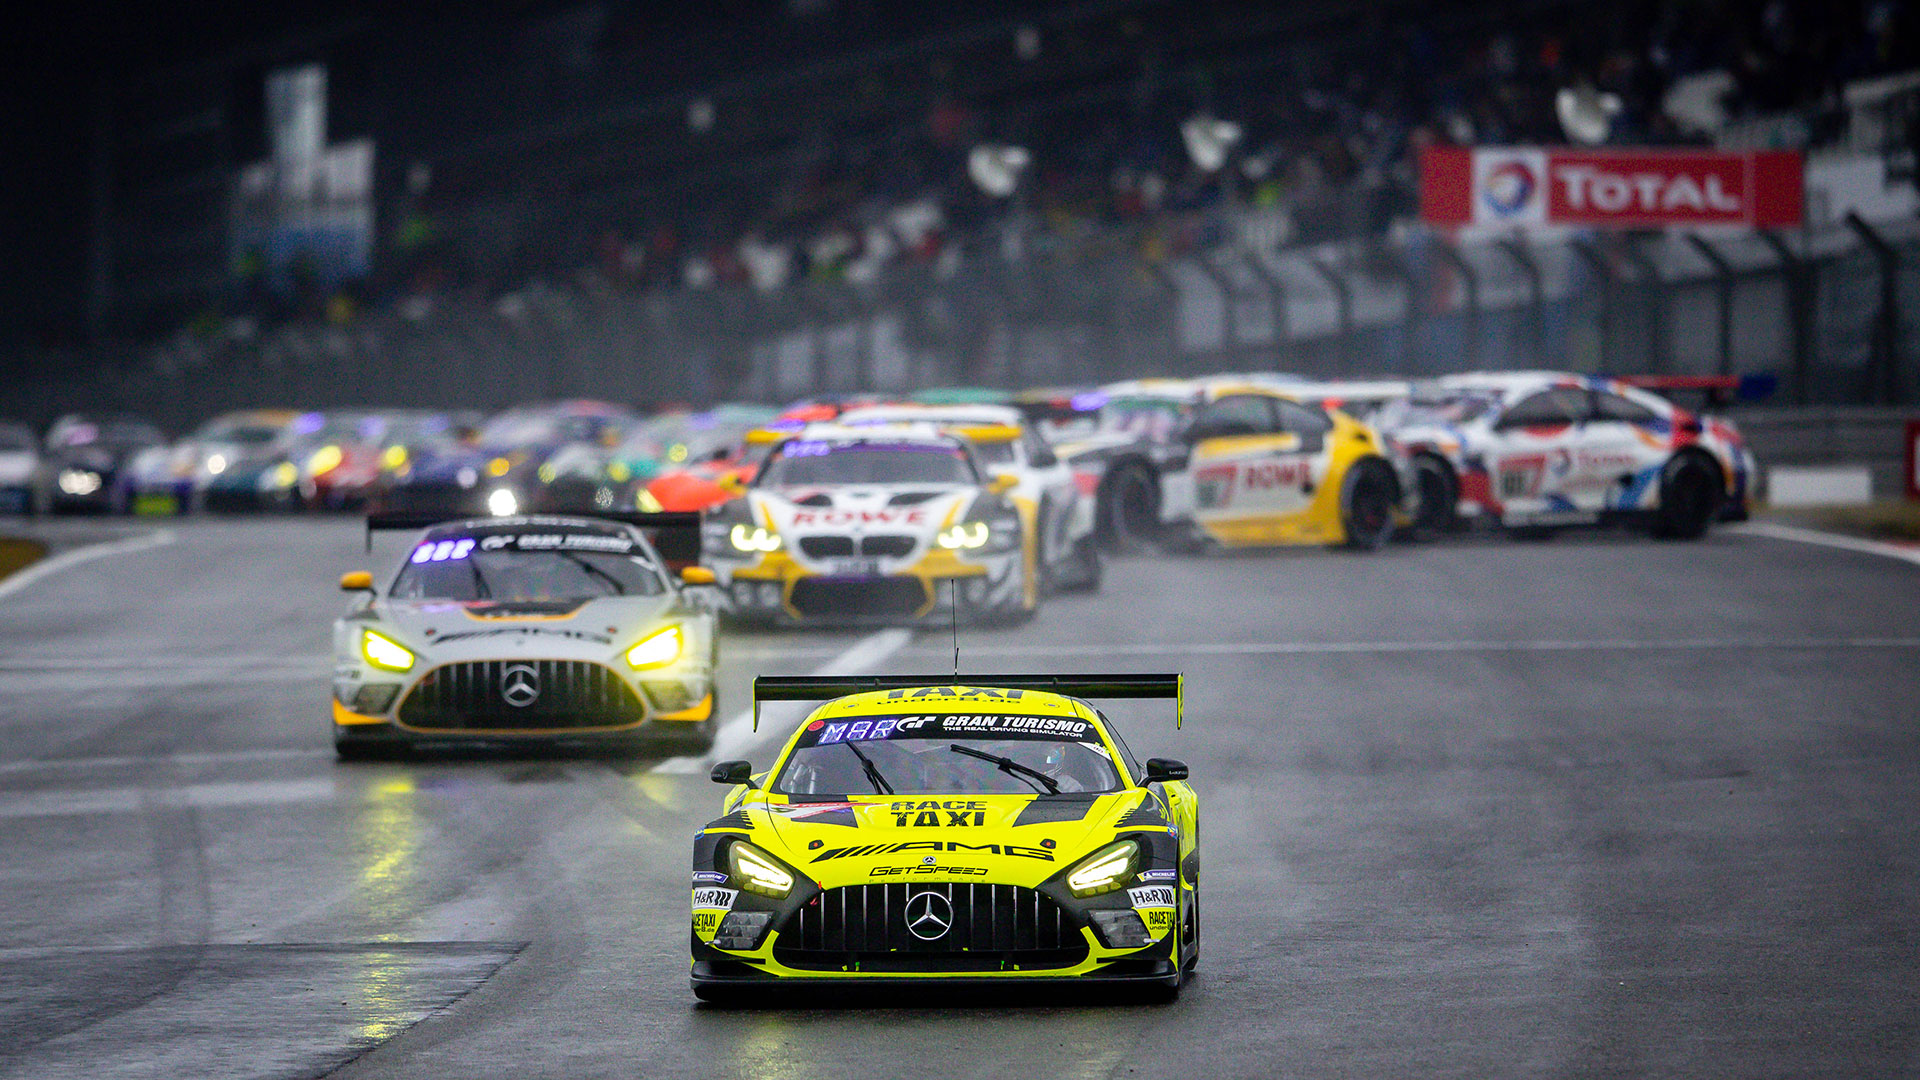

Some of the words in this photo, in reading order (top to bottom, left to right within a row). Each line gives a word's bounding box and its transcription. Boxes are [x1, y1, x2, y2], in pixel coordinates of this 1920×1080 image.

[1557, 164, 1740, 212] TOTAL
[792, 510, 927, 527] ROWE
[942, 716, 999, 727] GRAN
[999, 716, 1087, 733] TURISMO
[990, 726, 1029, 734] DRIVING
[1029, 729, 1083, 738] SIMULATOR
[890, 801, 988, 811] RACE
[890, 811, 985, 827] TAXI
[694, 890, 715, 904] H&R
[1132, 890, 1161, 904] H&R
